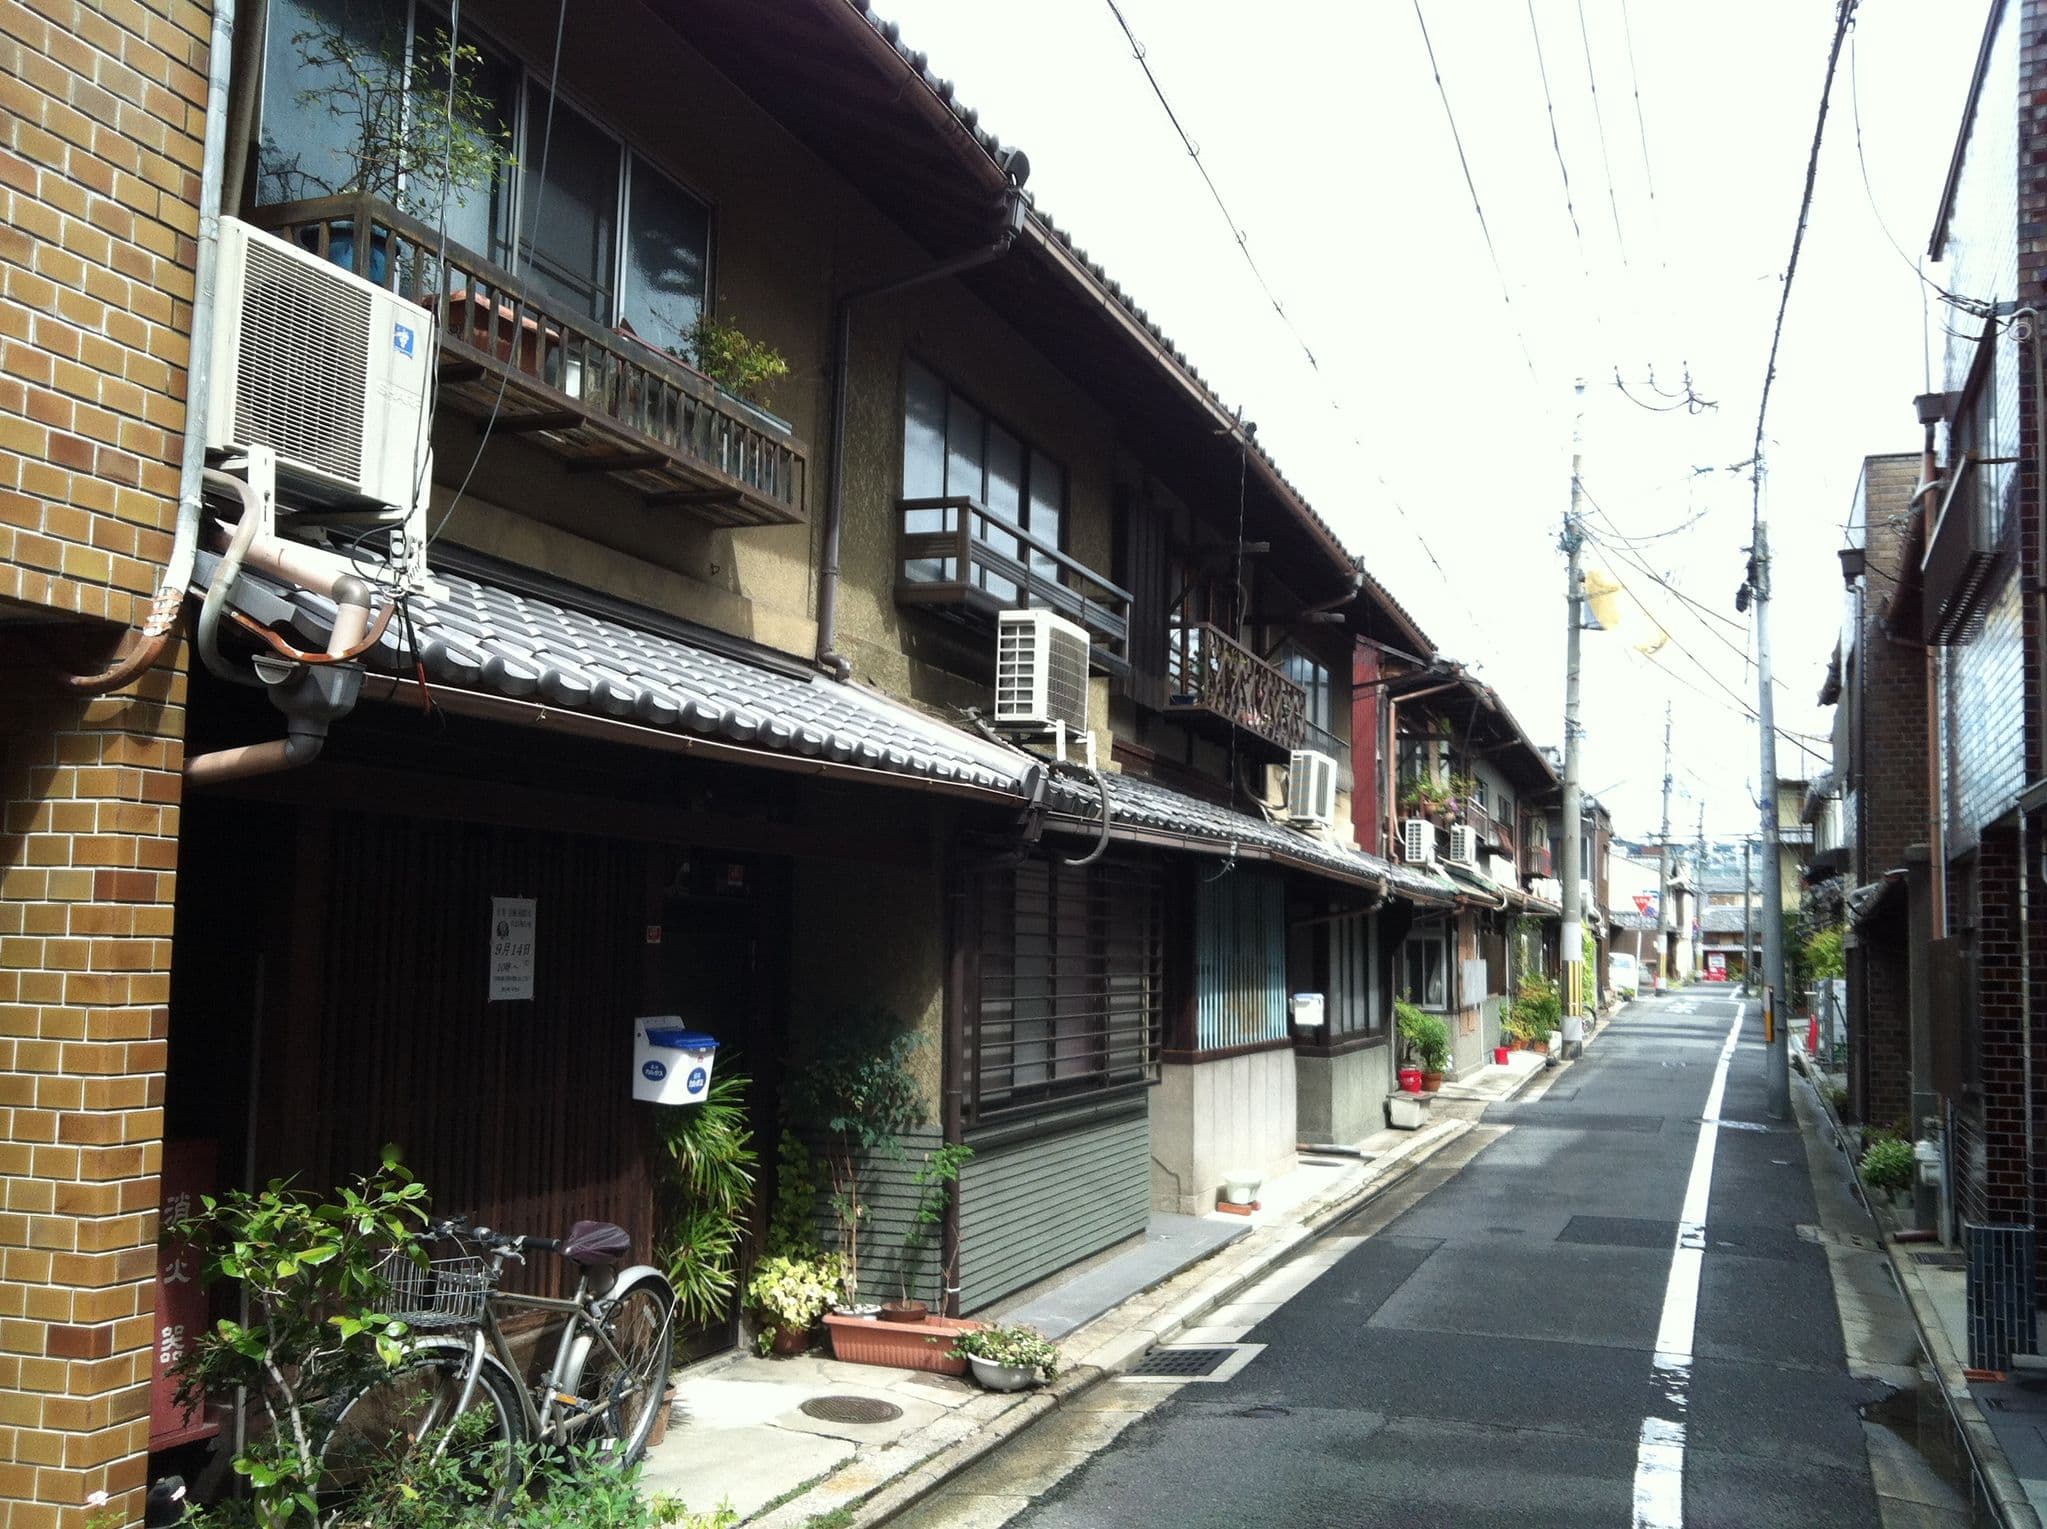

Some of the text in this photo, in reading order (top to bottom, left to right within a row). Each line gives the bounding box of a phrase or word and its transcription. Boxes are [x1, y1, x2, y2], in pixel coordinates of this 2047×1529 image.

[495, 943, 531, 956] 9月14日
[159, 1191, 192, 1363] 消火器
